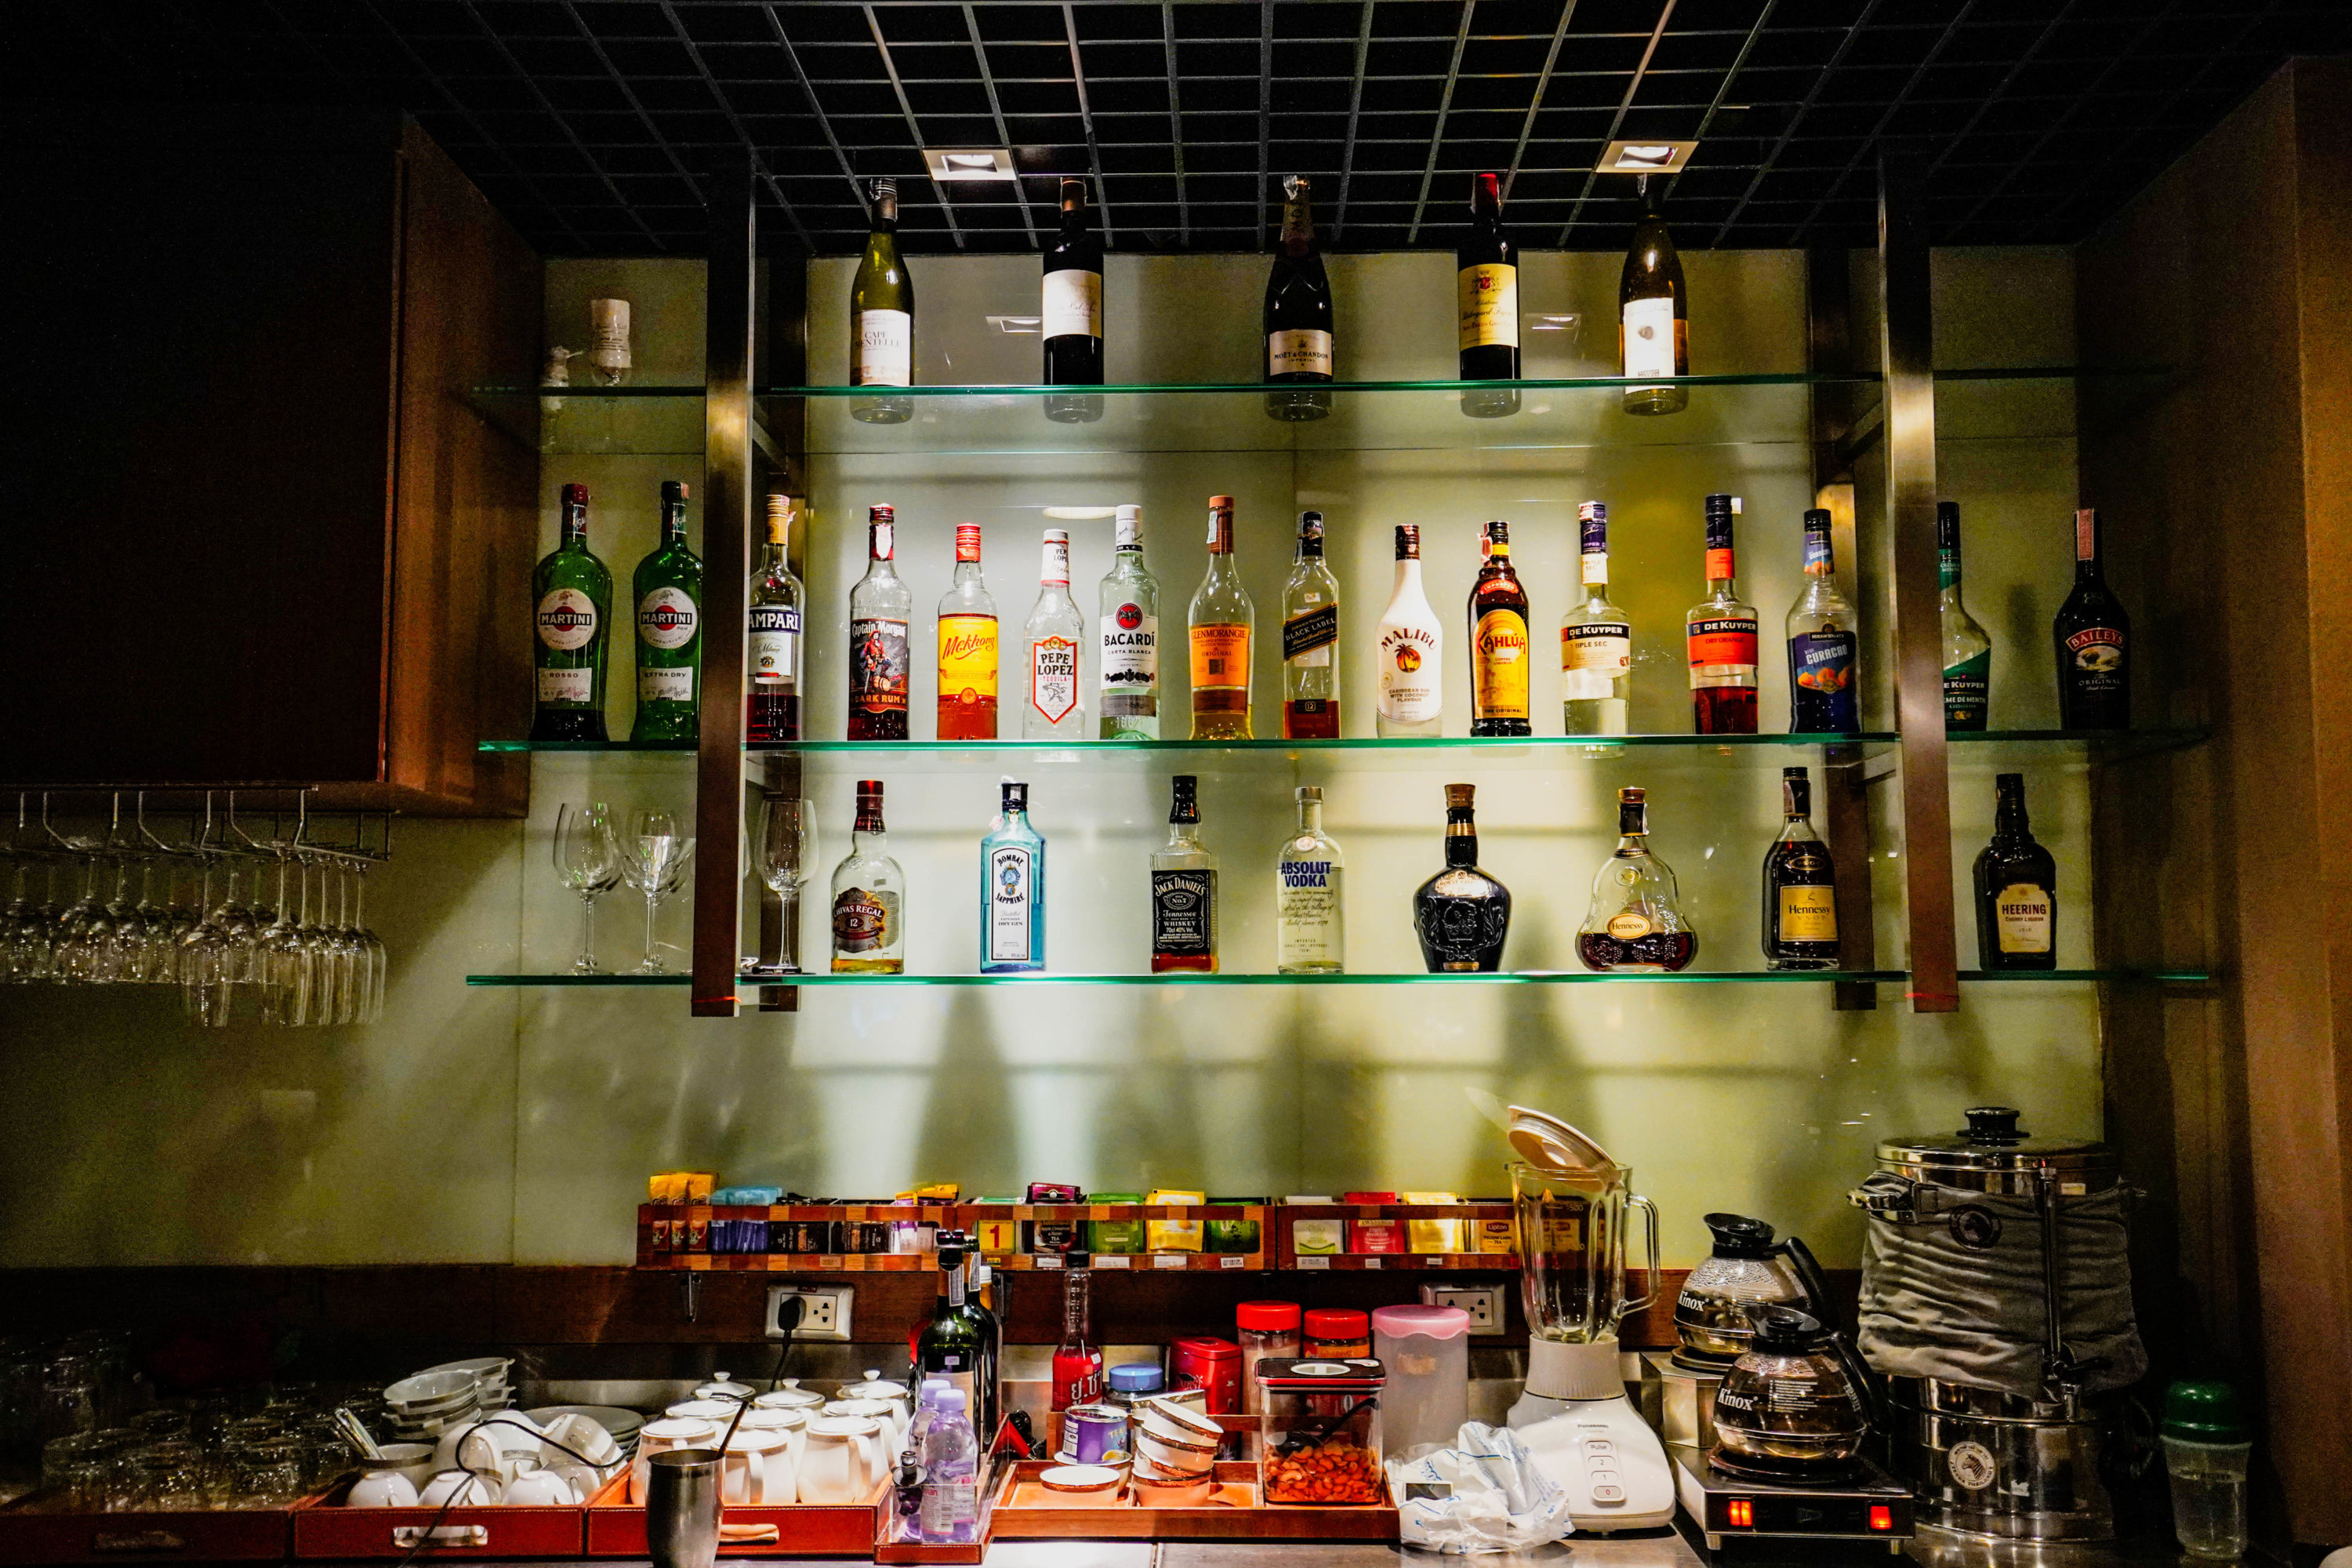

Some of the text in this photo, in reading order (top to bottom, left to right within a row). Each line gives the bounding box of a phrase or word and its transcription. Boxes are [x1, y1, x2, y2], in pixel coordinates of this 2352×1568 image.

[1298, 350, 1328, 359] CHANDON
[541, 613, 590, 625] MARTINI
[642, 612, 691, 624] MARTINI
[749, 612, 799, 630] AMPARI
[852, 621, 906, 638] Captain Morgan
[1191, 629, 1247, 639] GLENMORANGIE
[1285, 618, 1336, 641] BLACK LABEL
[1104, 631, 1155, 647] BACARDÍ
[1381, 627, 1436, 652] MALIBU
[1475, 630, 1526, 657] KAHLÚA
[2071, 630, 2124, 648] BAILEYS
[942, 634, 995, 660] Mekhong
[1041, 653, 1069, 664] PEPE
[1037, 665, 1073, 675] LOPEZ
[881, 695, 900, 703] RUM
[996, 854, 1025, 866] BOMBAY
[1281, 861, 1332, 875] ABSOLUT
[1155, 877, 1206, 897] JACK DANIEL'S
[1285, 875, 1327, 887] VODKA
[995, 893, 1025, 905] SAPPHIRE
[855, 905, 883, 918] REGAL
[1789, 904, 1831, 916] Hennessy
[2002, 904, 2046, 916] HEERING
[850, 918, 858, 927] 12
[1612, 922, 1643, 931] Hennessy
[990, 1225, 1000, 1248] 1
[1678, 1290, 1705, 1312] Kinox
[1718, 1388, 1753, 1411] Kinox
